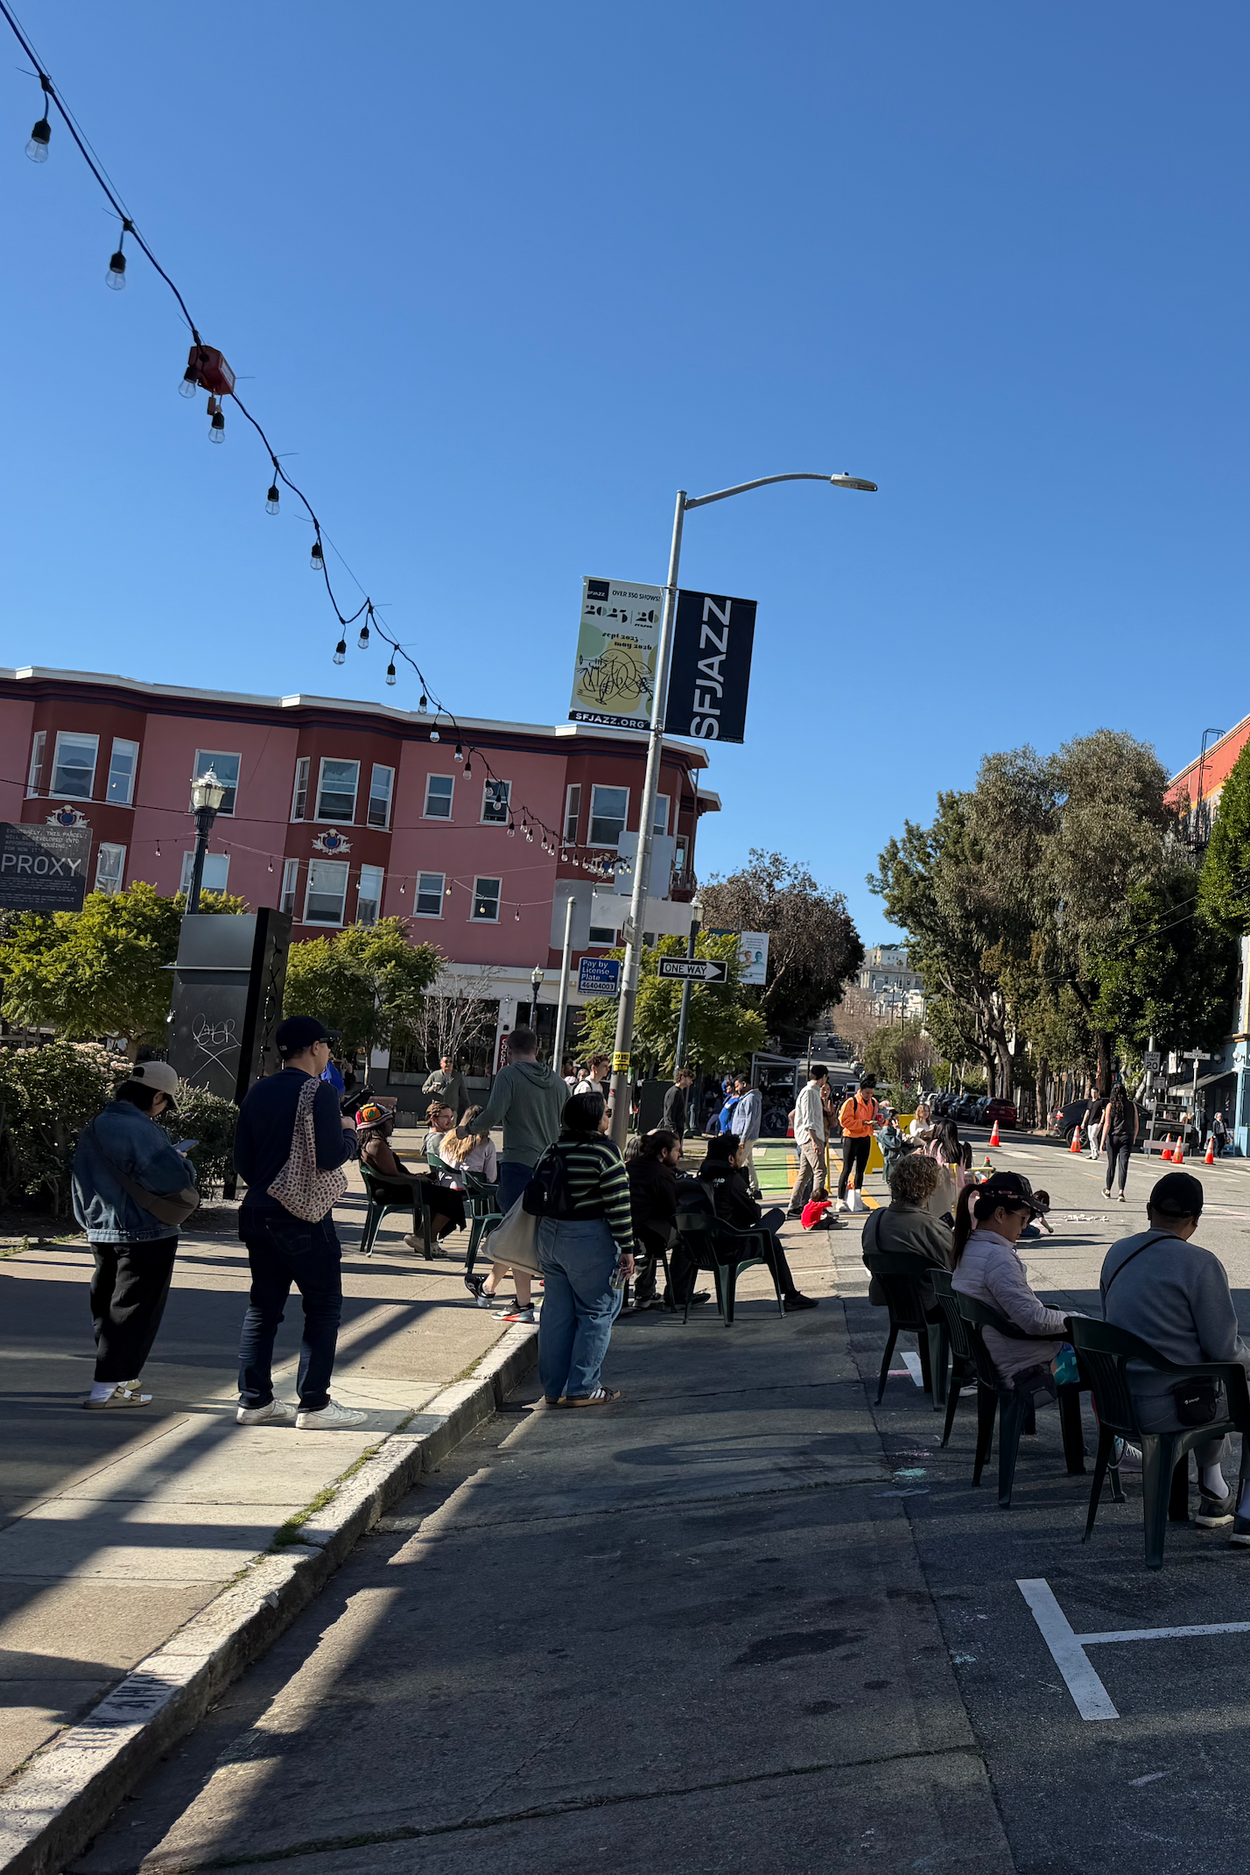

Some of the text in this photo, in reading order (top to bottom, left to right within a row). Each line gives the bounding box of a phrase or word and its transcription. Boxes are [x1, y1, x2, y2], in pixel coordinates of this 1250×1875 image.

[612, 589, 628, 598] OVER
[639, 593, 661, 602] SHOWS!
[602, 632, 620, 640] sept
[620, 634, 639, 643] 2025
[614, 641, 632, 649] may
[690, 597, 732, 740] SFJAZZ
[575, 712, 645, 729] SFJAZZ.ORG
[1, 853, 82, 877] PROXY
[583, 960, 609, 969] Pay by
[664, 963, 707, 975] ONE WAY
[582, 967, 610, 975] License
[581, 973, 601, 981] Plate
[1146, 1061, 1158, 1070] 20
